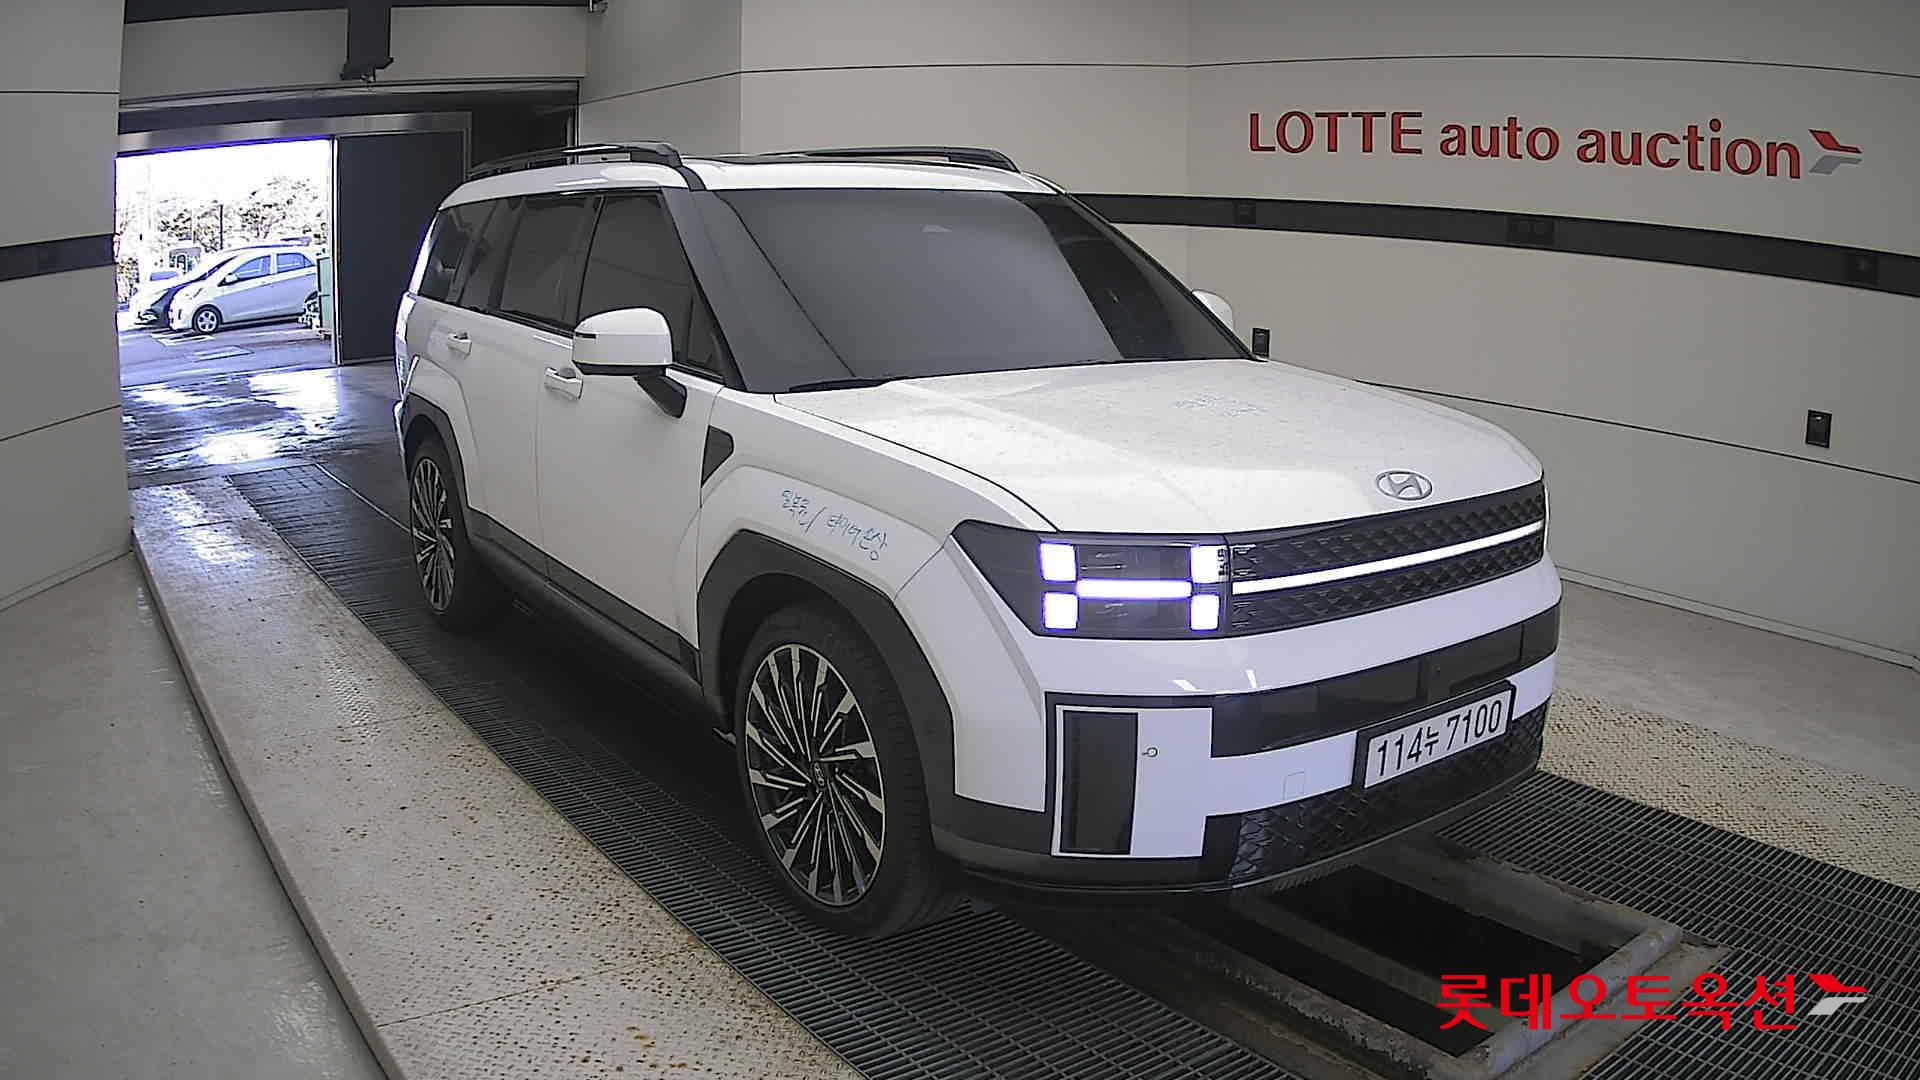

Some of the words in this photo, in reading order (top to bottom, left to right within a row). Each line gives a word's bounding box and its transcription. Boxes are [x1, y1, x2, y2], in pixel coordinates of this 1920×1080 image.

[1249, 111, 1424, 155] LOTTE
[1440, 116, 1560, 162] auto
[1576, 117, 1801, 180] auction
[1377, 726, 1440, 777] 114누
[1446, 700, 1502, 751] 7100
